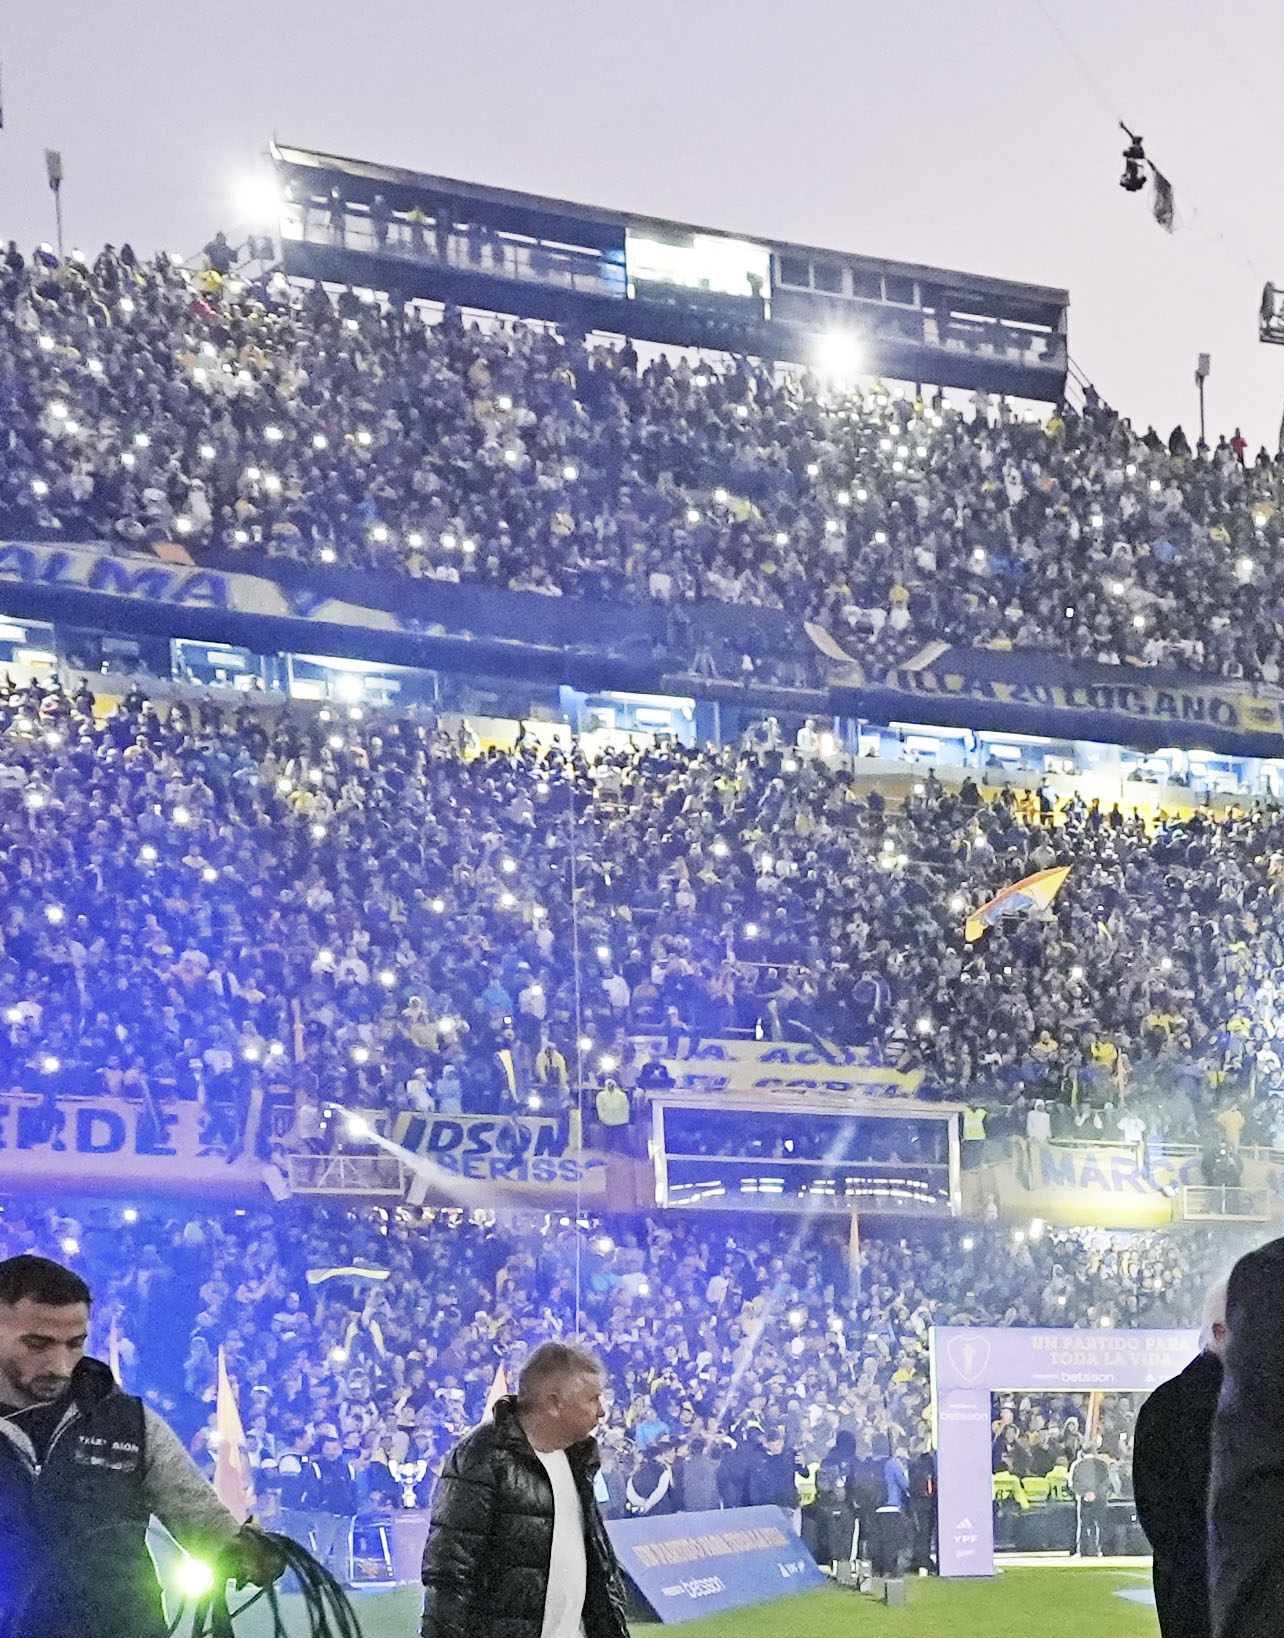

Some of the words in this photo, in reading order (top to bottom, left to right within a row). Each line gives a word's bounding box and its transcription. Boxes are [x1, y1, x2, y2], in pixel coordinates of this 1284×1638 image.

[436, 1152, 607, 1182] BERISS
[1063, 1336, 1141, 1350] PARTIDO
[1145, 1336, 1192, 1350] PARA
[1051, 1351, 1098, 1366] TODA
[1132, 1351, 1172, 1366] VIDA
